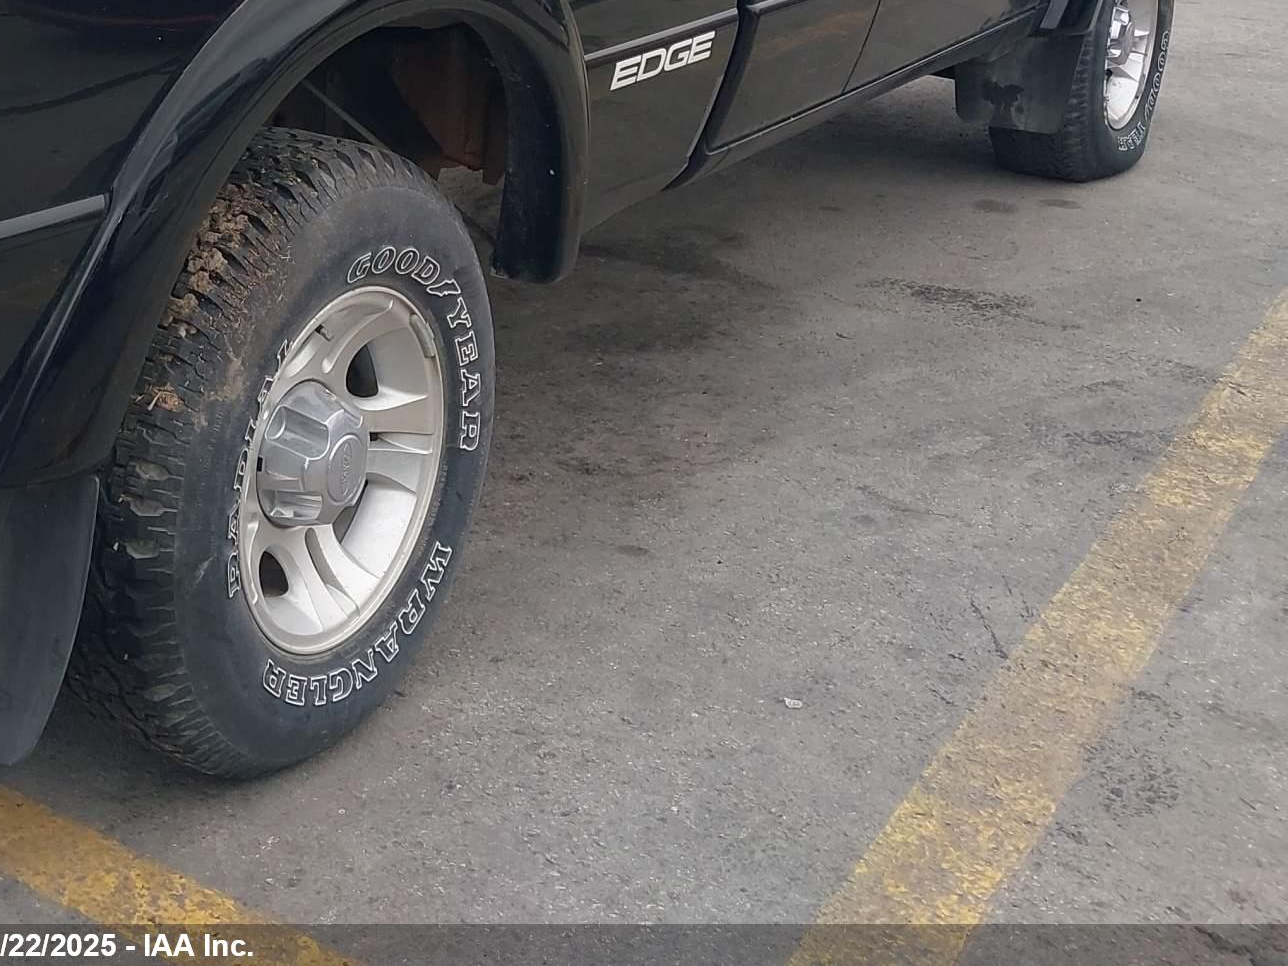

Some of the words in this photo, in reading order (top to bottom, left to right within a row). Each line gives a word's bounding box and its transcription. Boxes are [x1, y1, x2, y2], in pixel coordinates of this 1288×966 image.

[610, 30, 716, 90] EDGE
[347, 246, 482, 451] GOODYEAR
[262, 541, 453, 706] WRANGLER
